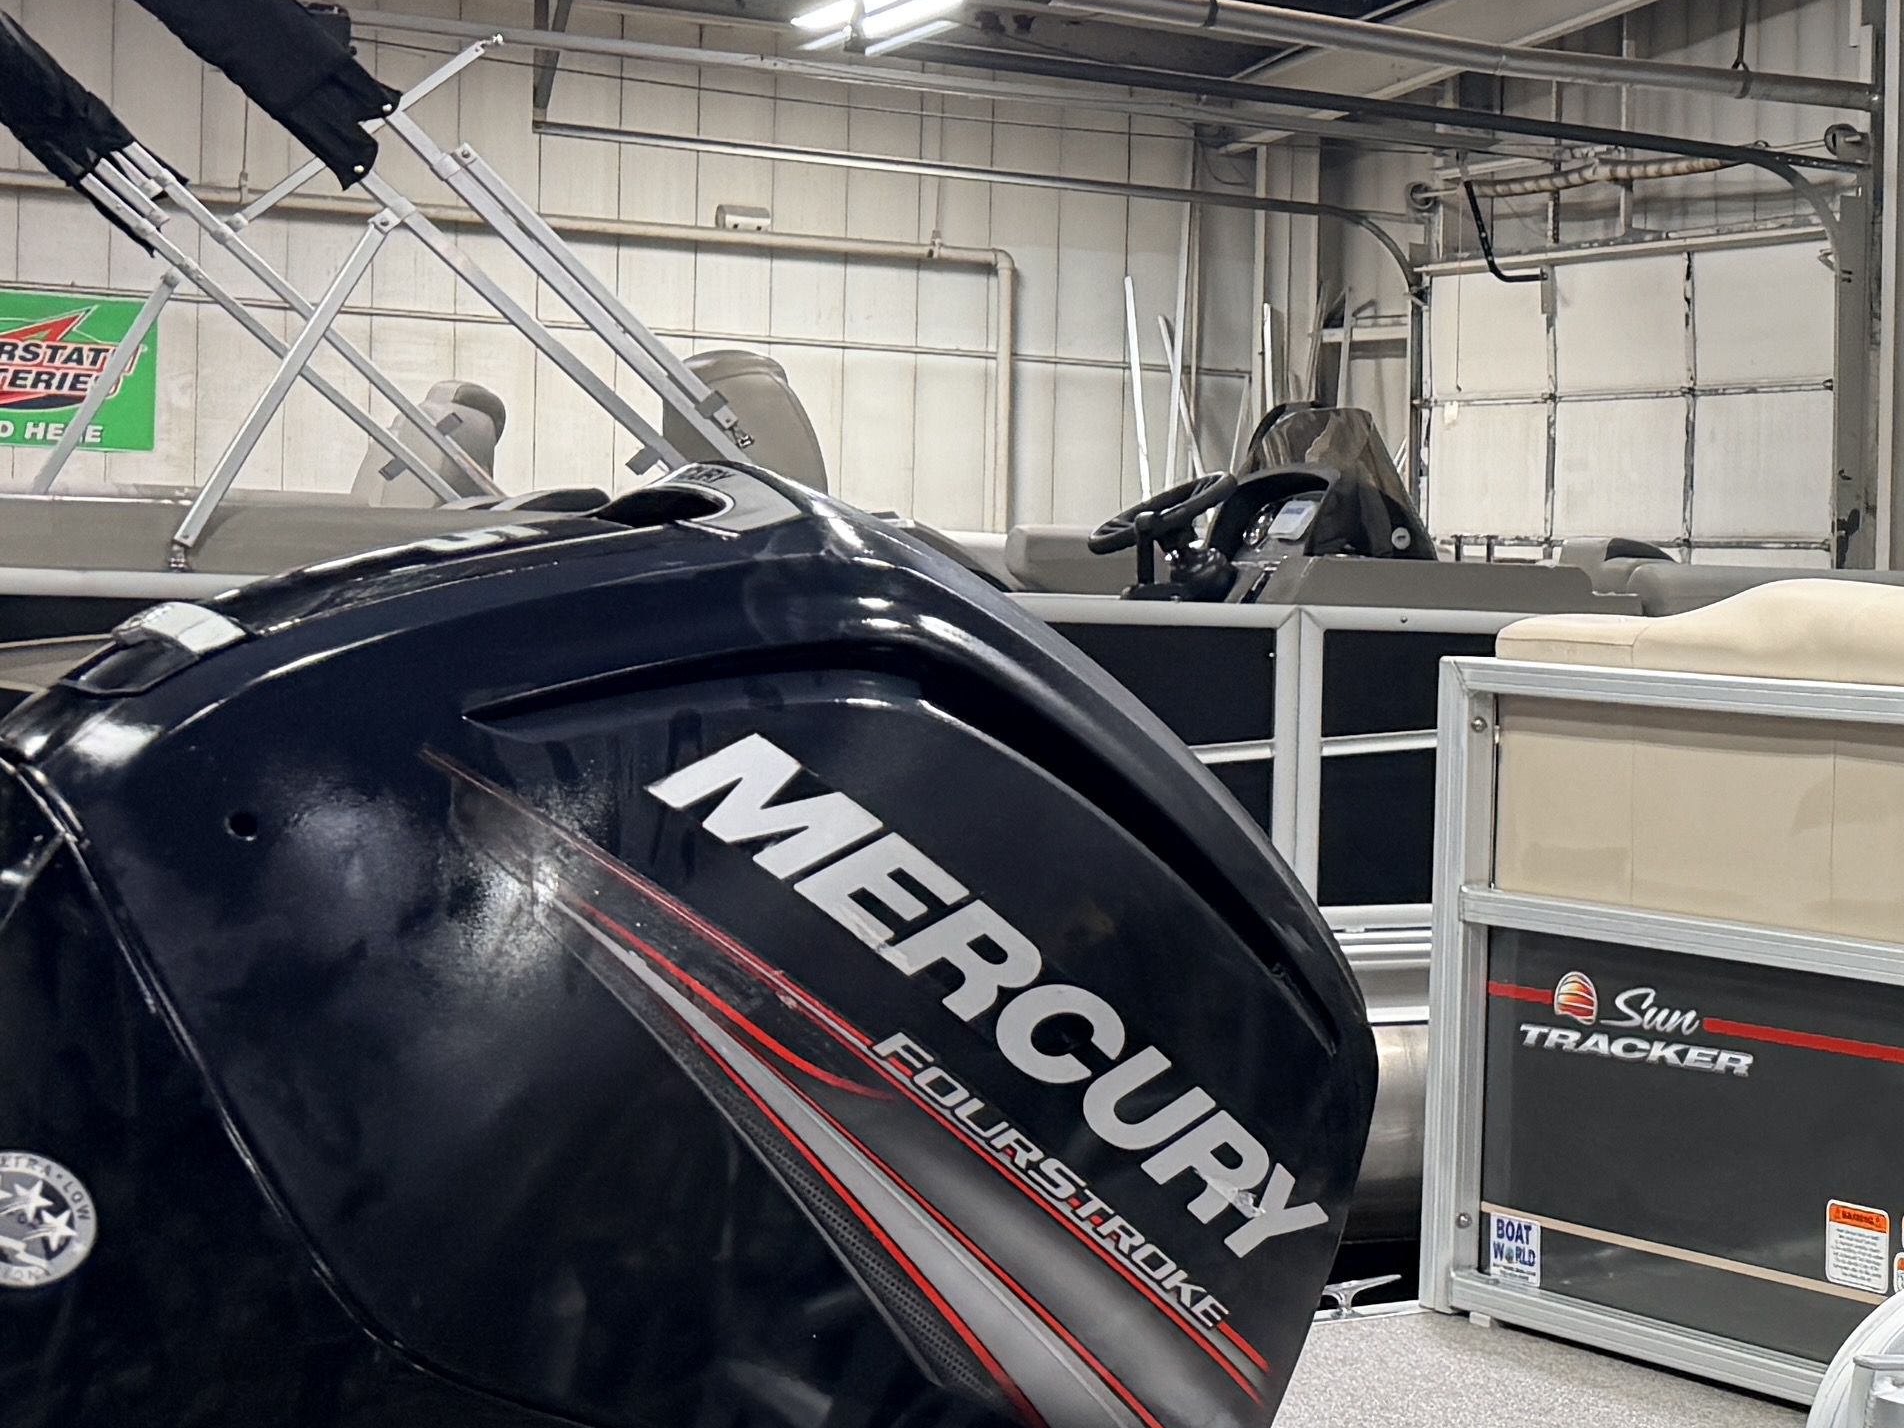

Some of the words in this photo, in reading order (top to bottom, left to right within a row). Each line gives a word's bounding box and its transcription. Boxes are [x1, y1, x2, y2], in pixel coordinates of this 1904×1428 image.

[0, 342, 120, 372] RSTAT
[24, 422, 103, 443] HEE
[645, 733, 1329, 1259] MERCURY
[1600, 987, 1700, 1036] Sun
[1520, 1023, 1754, 1077] TRACKER
[872, 1032, 1230, 1329] FOURSTROKE
[1496, 1218, 1532, 1245] BOAT
